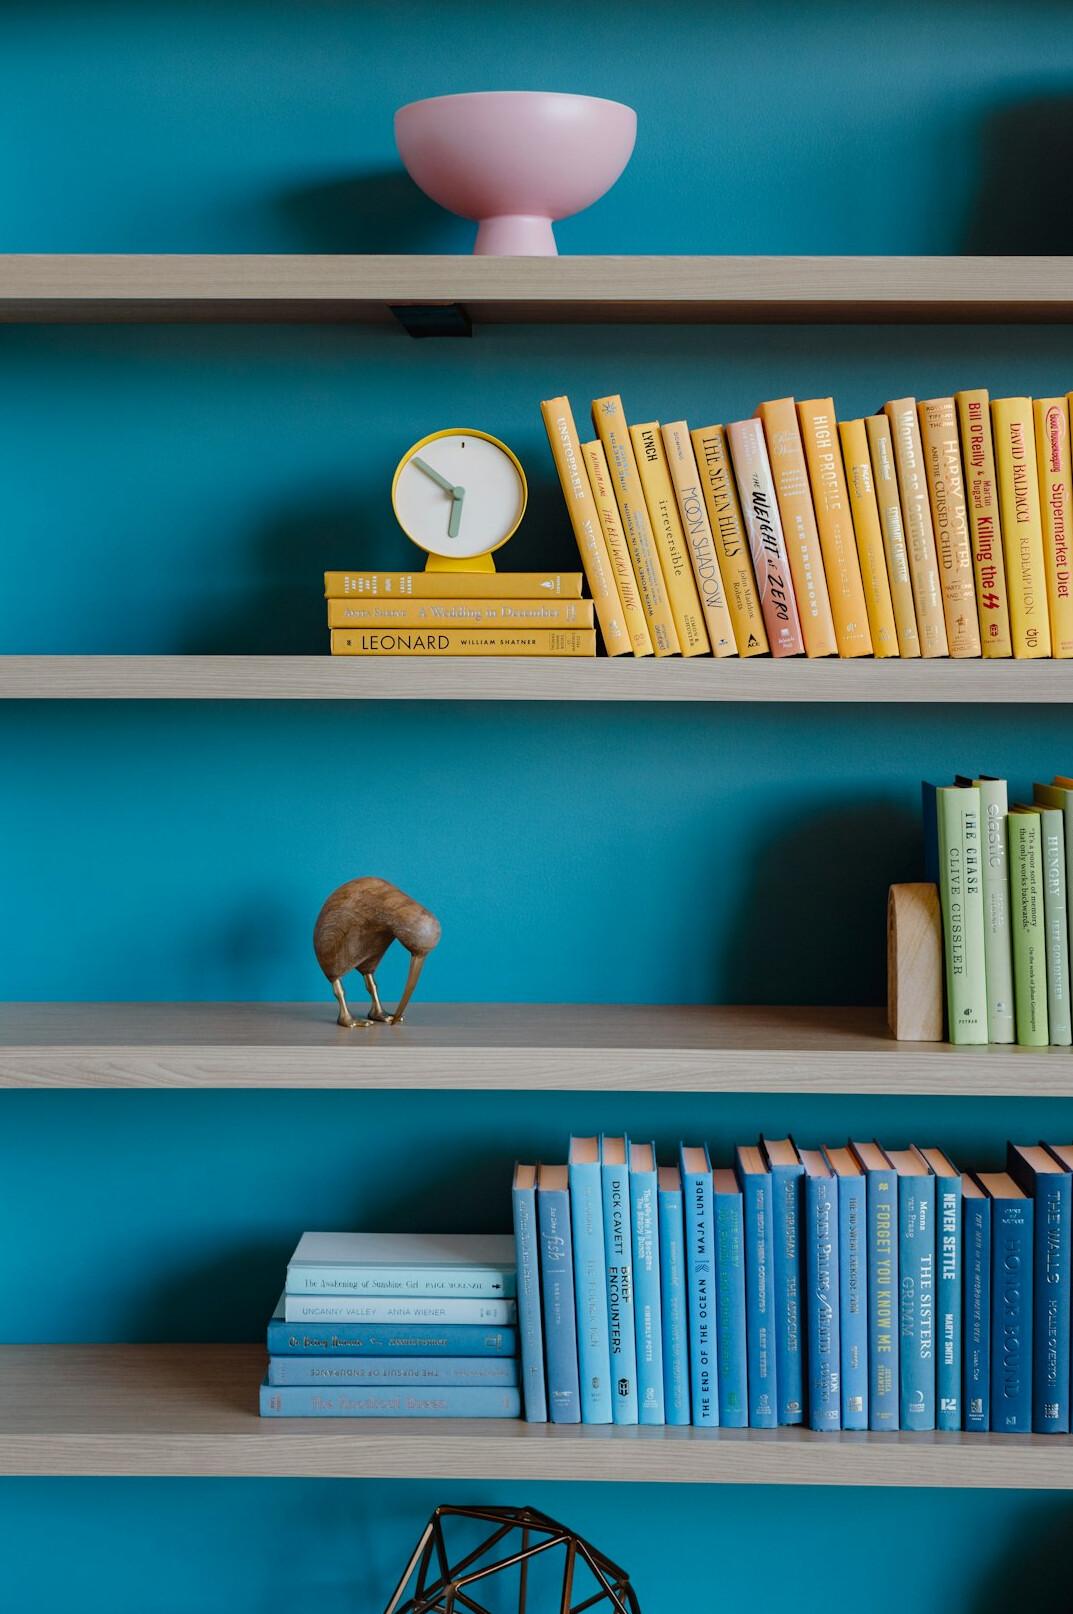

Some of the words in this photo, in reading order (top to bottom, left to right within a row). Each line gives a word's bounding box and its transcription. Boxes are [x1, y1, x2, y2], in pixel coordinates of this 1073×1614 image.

[968, 403, 981, 421] Bill
[1049, 414, 1060, 429] Good
[813, 415, 832, 449] HIGH
[898, 410, 916, 468] Women
[970, 424, 985, 467] O'Reilly
[1010, 423, 1025, 460] DAVID
[557, 417, 584, 499] UNSTOPPABLE
[610, 432, 621, 467] BRETON
[702, 434, 726, 466] THE
[1049, 430, 1062, 473] Housekeeping
[618, 471, 627, 493] JUNE
[752, 473, 760, 488] THE
[818, 453, 841, 512] PROFILE
[860, 464, 871, 493] PIGEON
[908, 473, 919, 490] as
[942, 440, 963, 499] HARRY
[642, 430, 658, 462] LYNCH
[659, 500, 682, 576] irreversible
[708, 468, 734, 513] SEVEN
[935, 481, 948, 528] CURSED
[972, 480, 983, 509] Dugard
[983, 480, 992, 506] Martin
[1012, 464, 1030, 524] BALDACCI
[624, 503, 634, 536] FASHION
[681, 487, 706, 534] MOON
[752, 491, 780, 558] WEIGHT
[796, 515, 805, 540] REE
[1050, 483, 1068, 567] Supermarket
[632, 538, 637, 546] IN
[718, 514, 744, 557] HILLS
[908, 494, 928, 562] Learners
[949, 506, 970, 569] POTTER
[976, 517, 995, 562] Killing
[602, 509, 613, 525] THE
[620, 581, 637, 611] THING
[940, 531, 952, 570] CHILD
[638, 566, 647, 592] MONEY
[692, 538, 723, 608] SHADOW
[737, 570, 748, 587] John
[800, 546, 818, 617] DRUMMOND
[981, 565, 997, 589] the
[1019, 538, 1035, 615] REDEMPTION
[1057, 572, 1070, 598] Diet
[418, 607, 427, 618] A
[430, 605, 481, 621] Wedding
[486, 606, 496, 617] in
[501, 605, 559, 617] December
[645, 594, 653, 617] WHEN
[733, 582, 743, 610] Roberts
[742, 589, 754, 619] Maddox
[767, 574, 789, 620] ZERO
[362, 635, 449, 650] LEONARD
[684, 614, 694, 647] SCHUSTER
[965, 812, 976, 839] THE
[986, 804, 1004, 868] elastic
[1019, 828, 1027, 843] that
[1019, 844, 1028, 862] only
[1028, 851, 1036, 869] poor
[1047, 836, 1060, 896] HUNGRY
[950, 848, 960, 895] CLIVE
[966, 848, 978, 894] CHASE
[1021, 864, 1029, 886] works
[1030, 886, 1037, 895] of
[1030, 896, 1038, 927] memory
[950, 903, 962, 975] CUSSLER
[1052, 920, 1060, 941] JEFF
[1029, 947, 1034, 955] On
[1052, 944, 1062, 1000] GORDINIER
[612, 1181, 621, 1208] DICK
[695, 1180, 704, 1216] LUNDE
[784, 1180, 795, 1209] JOHN
[1047, 1190, 1060, 1224] THE
[816, 1202, 831, 1240] SEVEN
[876, 1204, 891, 1253] FORGET
[905, 1214, 916, 1238] Praag
[919, 1201, 928, 1231] Menna
[943, 1193, 956, 1232] NEVER
[542, 1232, 565, 1261] fish
[613, 1212, 623, 1255] CAVETT
[697, 1222, 705, 1253] MAJA
[785, 1211, 795, 1259] GRISHAM
[817, 1243, 832, 1291] PILLARS
[876, 1259, 891, 1284] YOU
[920, 1253, 932, 1289] THE
[943, 1236, 956, 1280] SETTLE
[1046, 1228, 1060, 1283] WALLS
[305, 1279, 316, 1288] The
[361, 1280, 369, 1288] of
[372, 1280, 401, 1289] Sunshine
[406, 1281, 418, 1289] Girl
[620, 1266, 631, 1304] BRIEF
[787, 1276, 796, 1297] THE
[1003, 1239, 1020, 1316] HONOR
[609, 1267, 621, 1354] ENCOUNTERS
[698, 1279, 707, 1318] OCEAN
[877, 1290, 891, 1329] KNOW
[901, 1276, 914, 1337] GRIMM
[699, 1325, 708, 1344] THE
[787, 1300, 797, 1351] ASSOCIATE
[818, 1307, 833, 1354] HEALTH
[920, 1294, 931, 1359] SISTERS
[944, 1313, 953, 1339] MARTY
[1048, 1300, 1057, 1336] HOLLIE
[701, 1350, 708, 1365] OF
[877, 1334, 891, 1353] ME
[944, 1341, 953, 1364] SMITH
[310, 1368, 365, 1377] ENDURANCE
[365, 1368, 378, 1376] OF
[381, 1368, 419, 1376] PURSUIT
[420, 1368, 439, 1376] THE
[1003, 1324, 1020, 1399] BOUND
[1048, 1338, 1057, 1387] OVERTON
[701, 1372, 709, 1391] END
[830, 1373, 839, 1392] DON
[702, 1398, 710, 1418] THE
